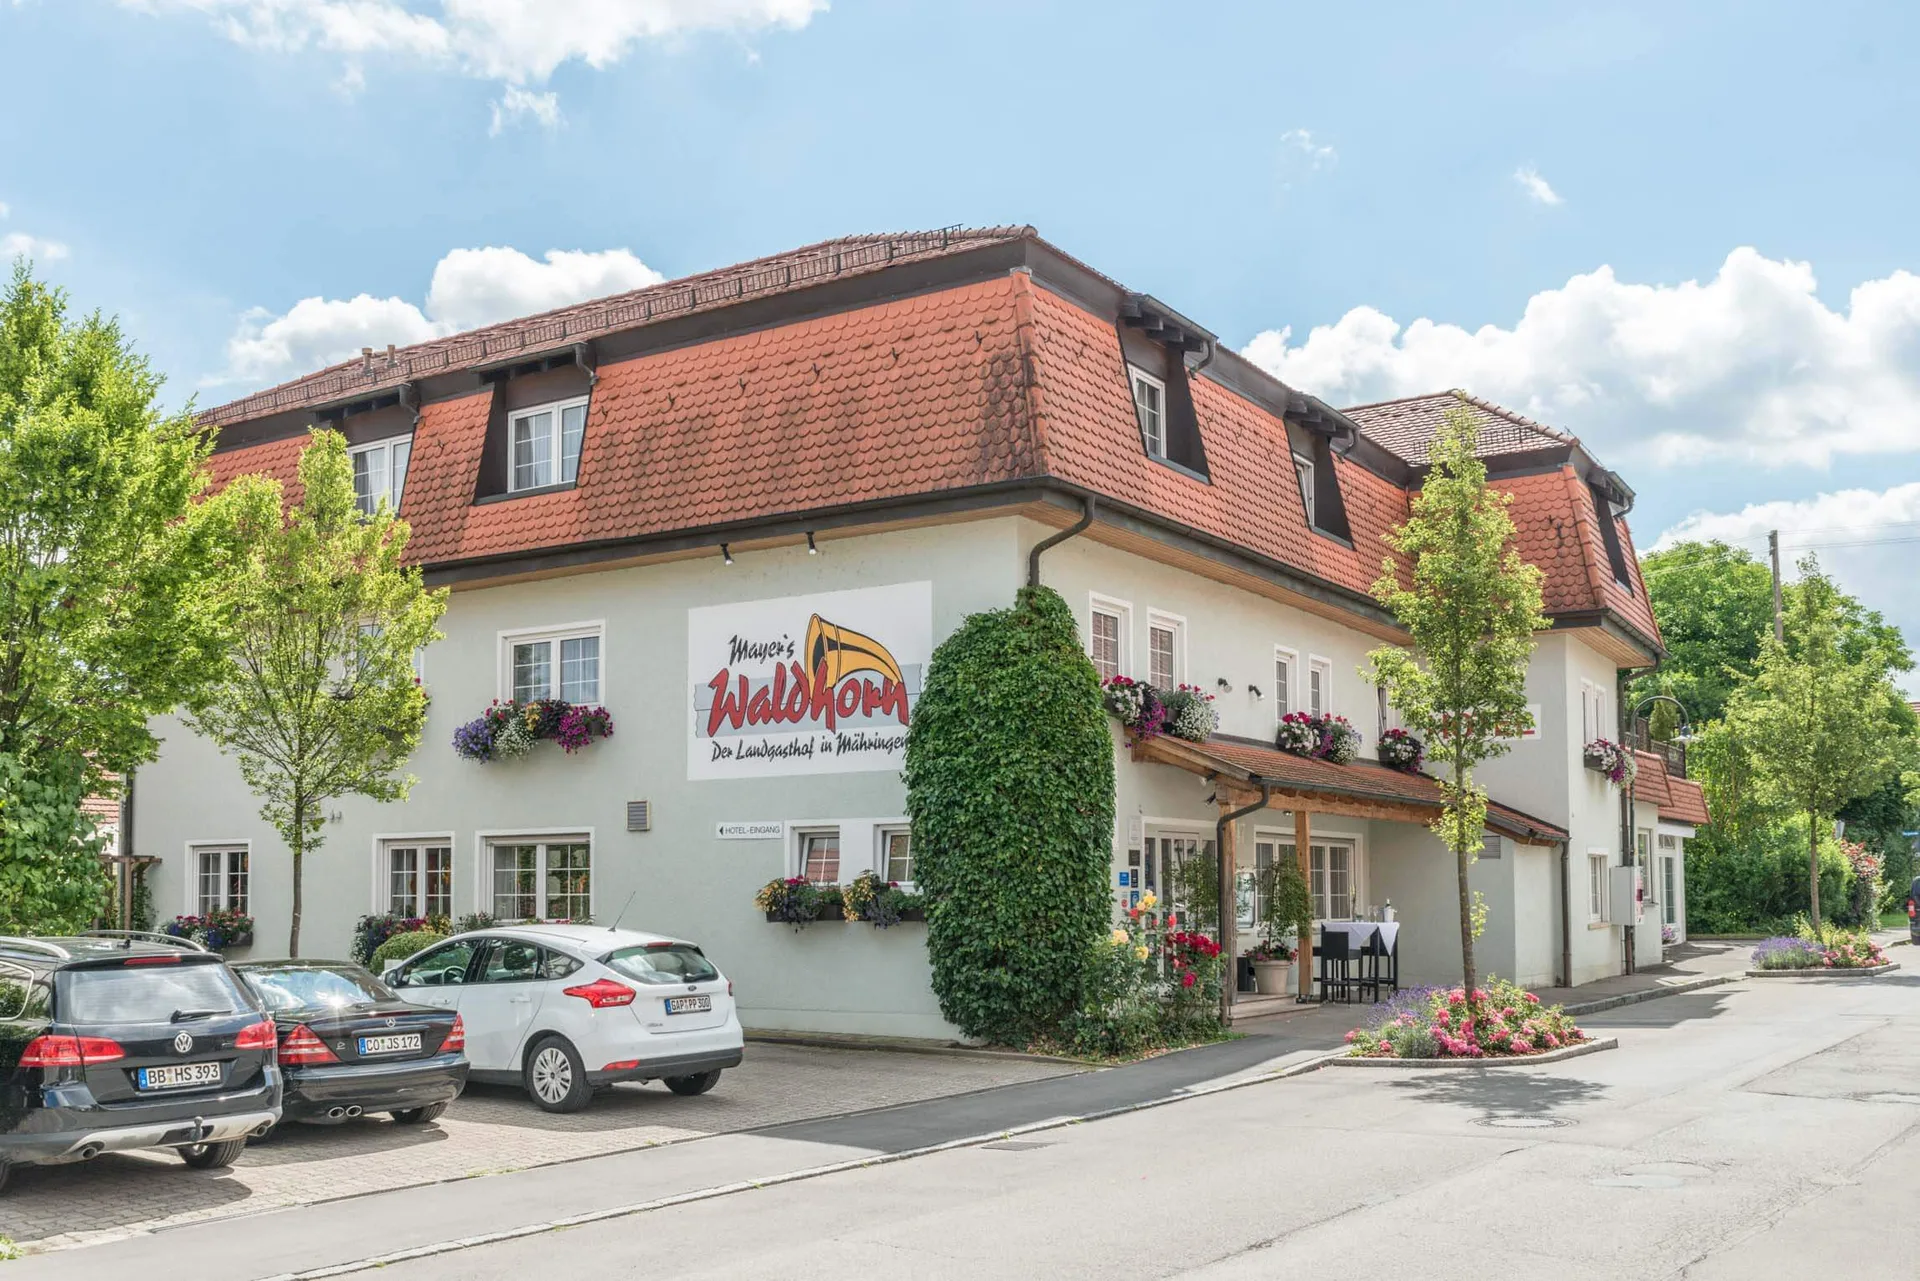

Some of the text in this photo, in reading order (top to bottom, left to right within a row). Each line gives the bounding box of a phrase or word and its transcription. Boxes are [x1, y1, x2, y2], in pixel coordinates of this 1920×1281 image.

[707, 657, 909, 737] Waldhorn
[711, 740, 733, 762] Der
[736, 736, 814, 763] Landgasthof
[820, 735, 833, 752] in
[366, 1035, 419, 1051] CO JS 172
[148, 1069, 166, 1085] BB
[174, 1066, 193, 1081] HS
[195, 1064, 219, 1080] 393
